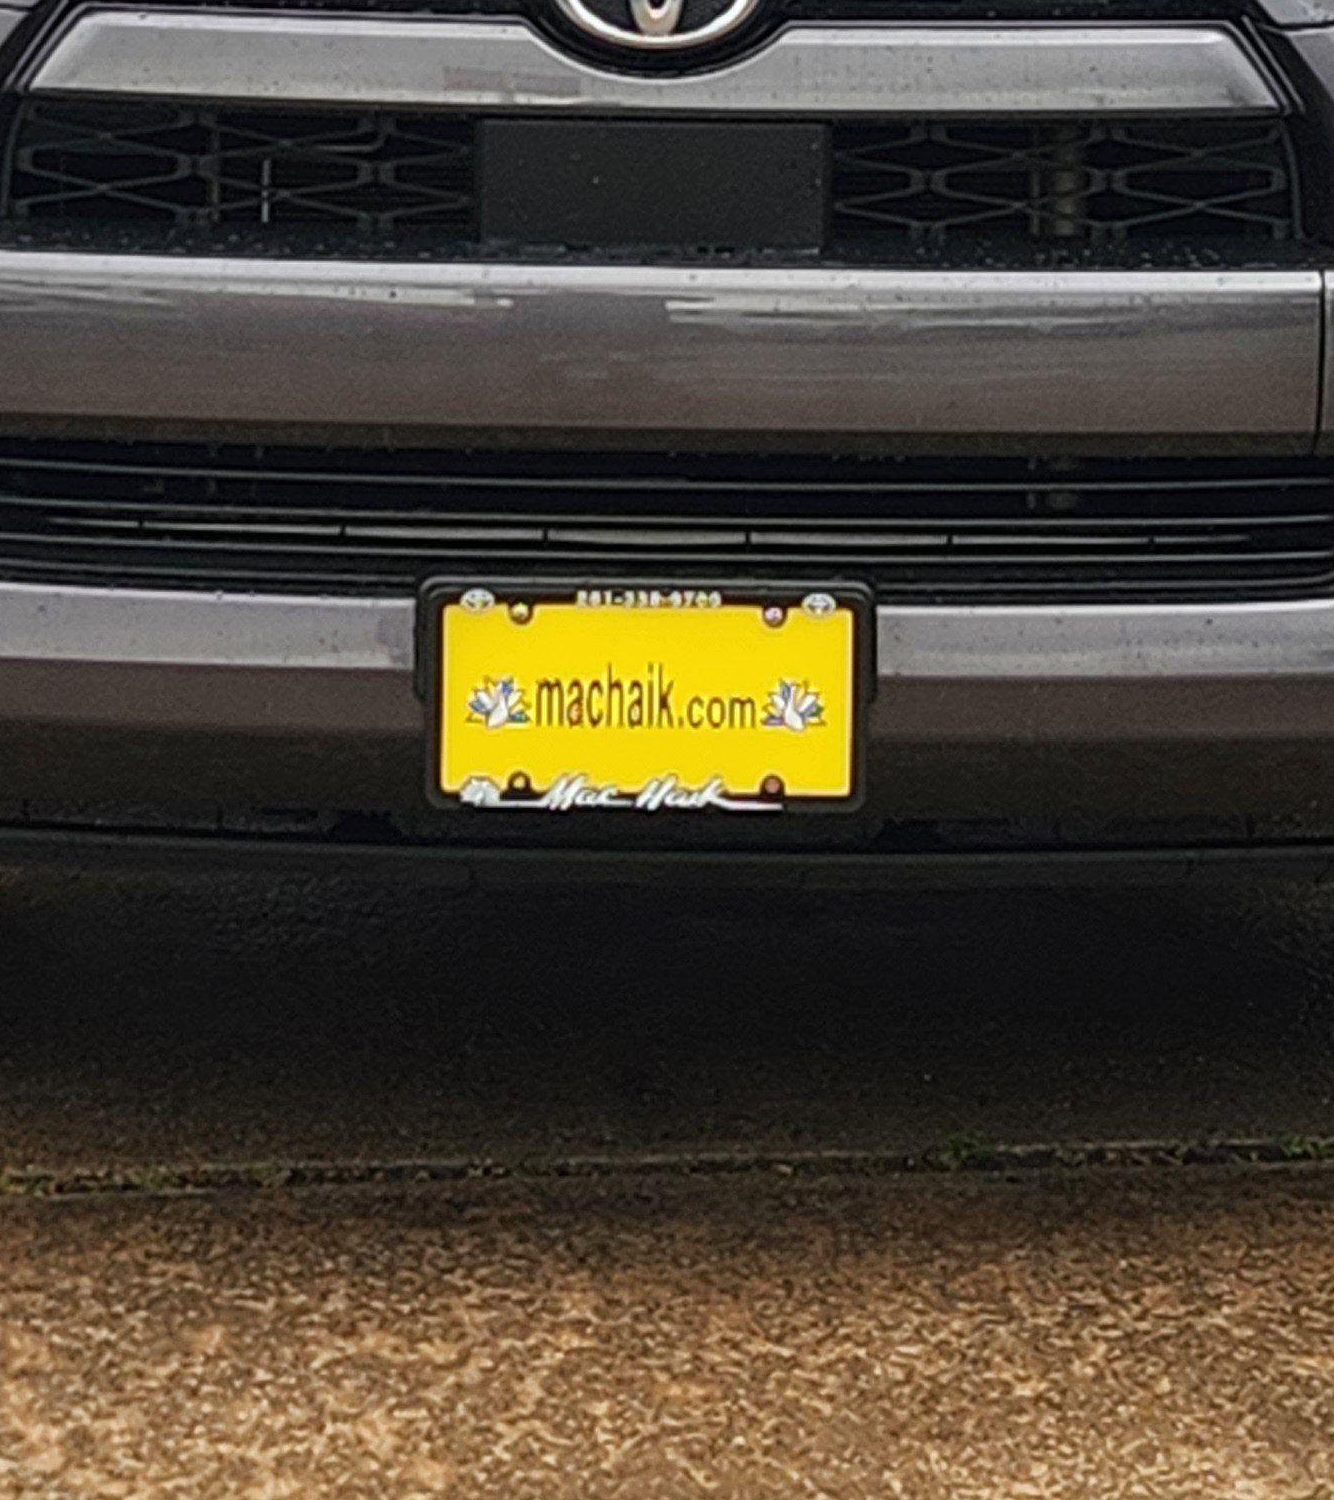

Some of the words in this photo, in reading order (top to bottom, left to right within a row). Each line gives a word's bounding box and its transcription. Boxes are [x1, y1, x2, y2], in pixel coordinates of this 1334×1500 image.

[534, 663, 758, 729] machaik.com
[541, 773, 627, 811] Mac
[633, 774, 729, 811] Haik
